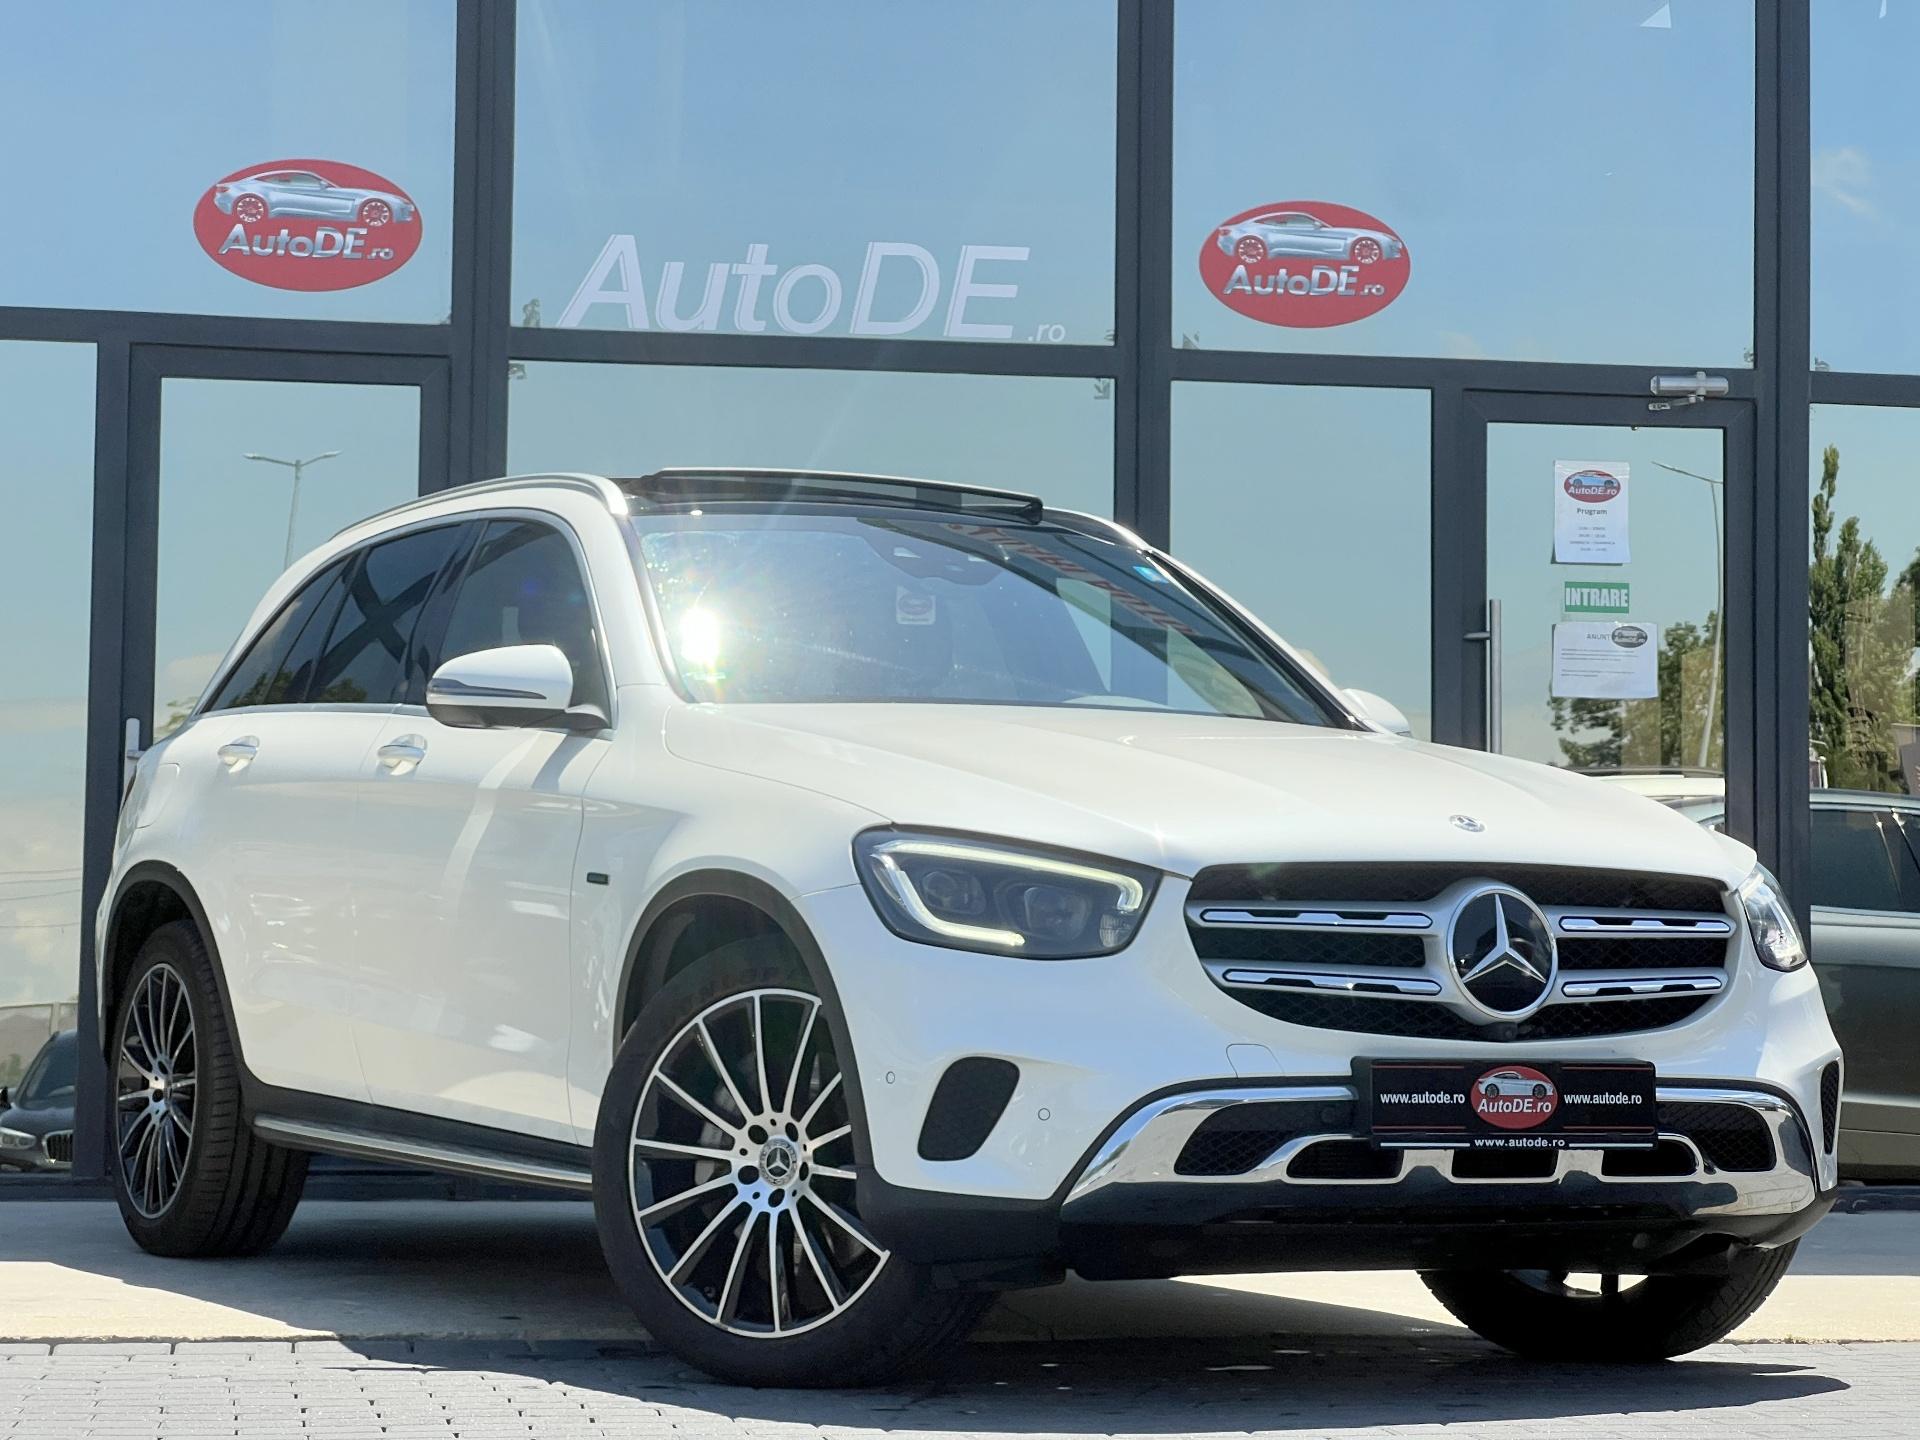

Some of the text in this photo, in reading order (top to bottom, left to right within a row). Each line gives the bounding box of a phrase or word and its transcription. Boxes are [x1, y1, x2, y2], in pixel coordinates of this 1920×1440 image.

[1568, 485, 1618, 496] AutoDE.ro
[1576, 507, 1608, 516] Program
[1565, 587, 1628, 607] INTRARE
[1380, 1090, 1466, 1105] www.autode.ro
[1564, 1092, 1643, 1106] www.autode.ro
[1477, 1098, 1553, 1114] AutoDE.ro
[1474, 1137, 1566, 1148] www.autode.ro
